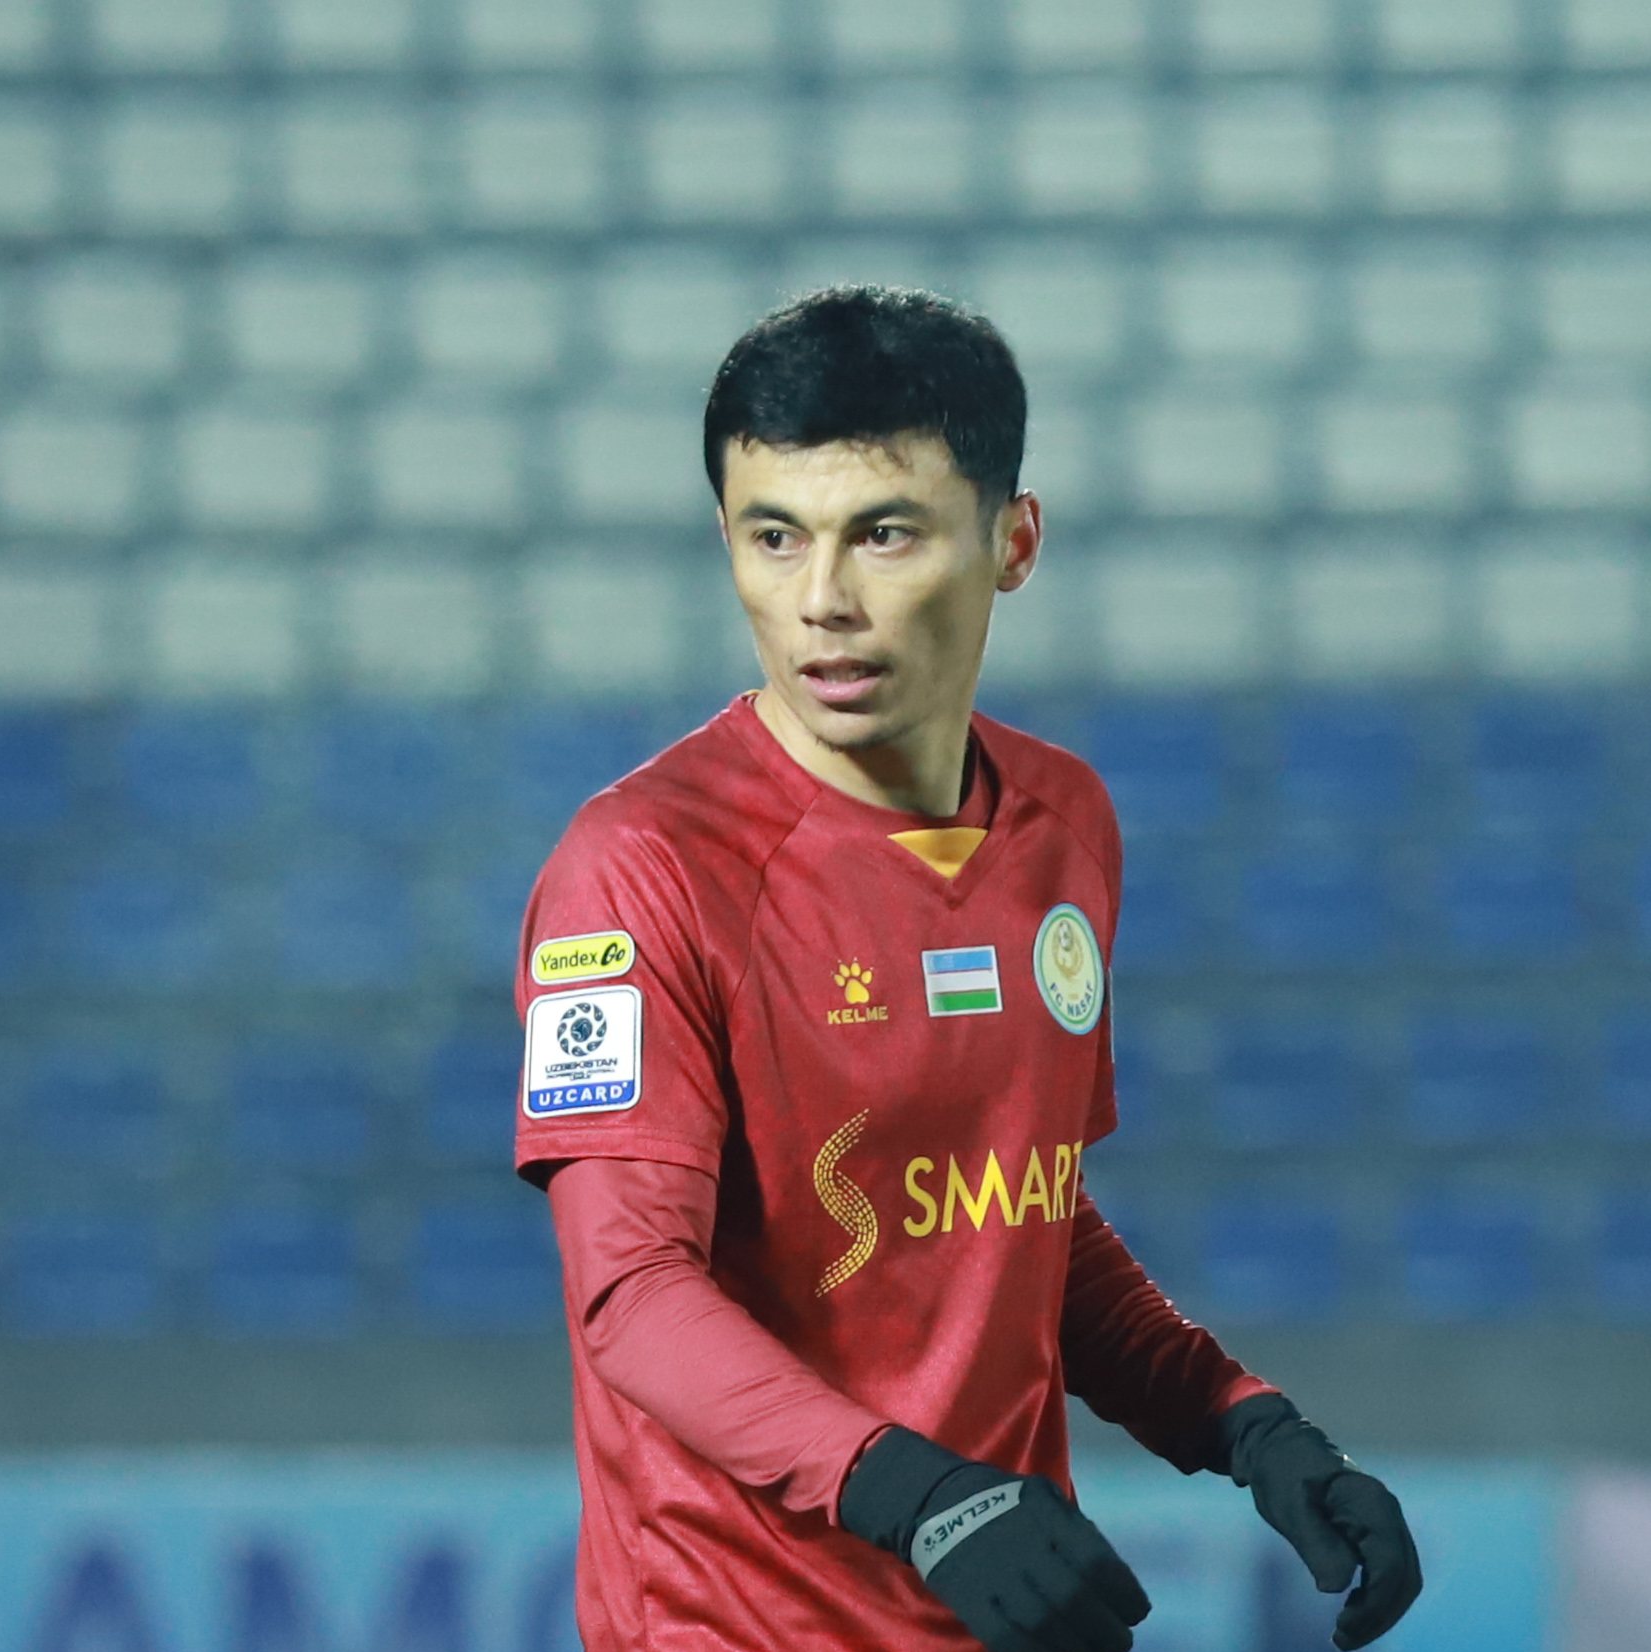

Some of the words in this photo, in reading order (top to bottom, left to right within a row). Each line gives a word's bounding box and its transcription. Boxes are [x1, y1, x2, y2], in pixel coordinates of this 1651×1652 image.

[540, 949, 598, 972] Yandex
[600, 942, 627, 967] Go
[827, 1005, 889, 1025] KELME
[538, 1083, 624, 1107] UZCARD
[903, 1140, 1083, 1238] SMART
[934, 1492, 1007, 1543] KELME
